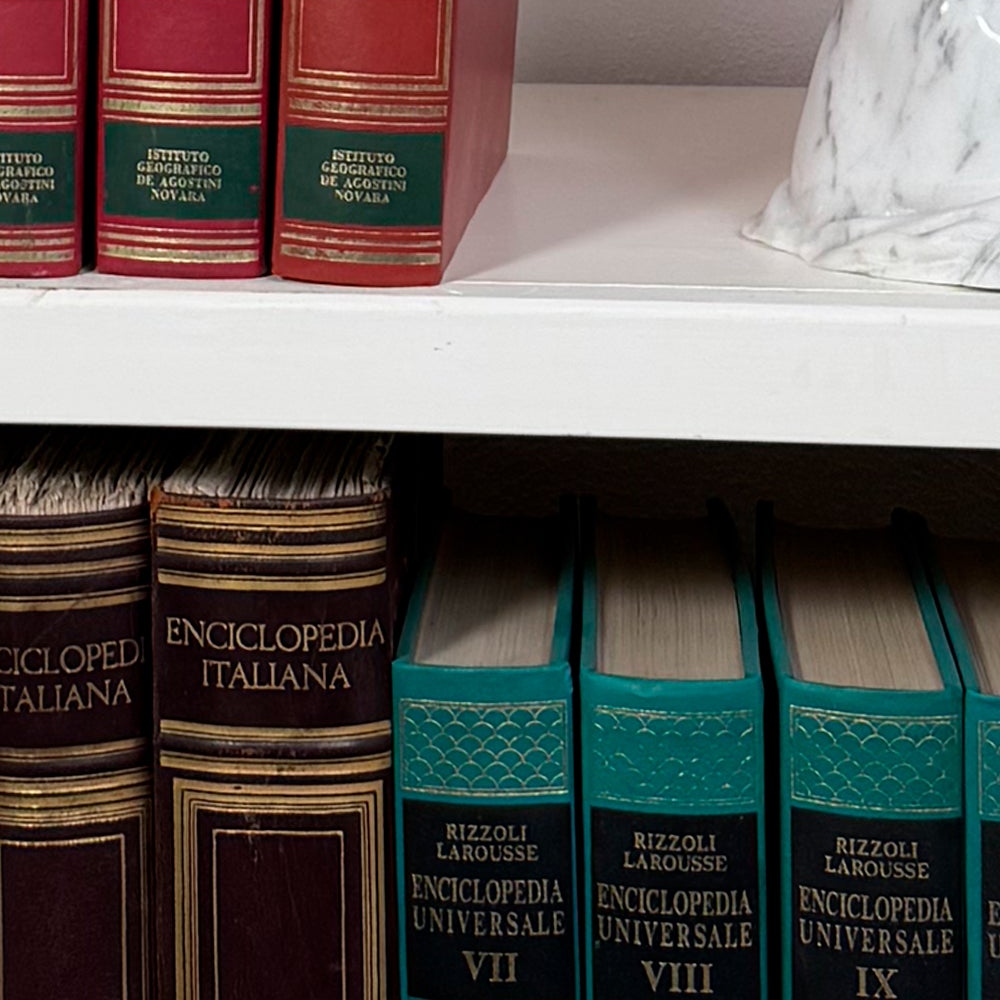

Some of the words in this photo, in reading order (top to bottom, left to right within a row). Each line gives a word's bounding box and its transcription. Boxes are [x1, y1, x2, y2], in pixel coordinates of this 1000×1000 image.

[148, 149, 209, 163] ISTITUTO
[332, 149, 395, 164] ISTITUTO
[137, 161, 222, 176] GEOGRAFICO
[321, 161, 407, 177] GEOGRAFICO
[0, 179, 55, 190] GOSTINI
[136, 175, 154, 186] DE
[160, 176, 222, 189] AGOSTINI
[320, 175, 338, 186] DE
[343, 178, 407, 192] AGOSTINI
[0, 191, 39, 203] VARA
[151, 188, 205, 202] NOVARA
[335, 190, 390, 203] NOVARA
[166, 616, 385, 652] ENCICLOPEDIA
[202, 659, 351, 690] ITALIANA
[446, 824, 528, 842] RIZZOLI
[634, 832, 716, 852] RIZZOLI
[436, 843, 539, 862] LAROUSSE
[836, 837, 919, 859] RIZZOLI
[623, 851, 728, 873] LAROUSSE
[824, 855, 930, 879] LAROUSSE
[412, 874, 564, 904] ENCICLOPEDIA
[597, 883, 753, 916] ENCICLOPEDIA
[799, 886, 953, 922] ENCICLOPEDIA
[413, 907, 565, 936] UNIVERSALE
[597, 915, 752, 949] UNIVERSALE
[799, 919, 954, 955] UNIVERSALE
[463, 951, 518, 983] VII
[641, 960, 714, 994] VIII
[855, 966, 898, 999] IX
